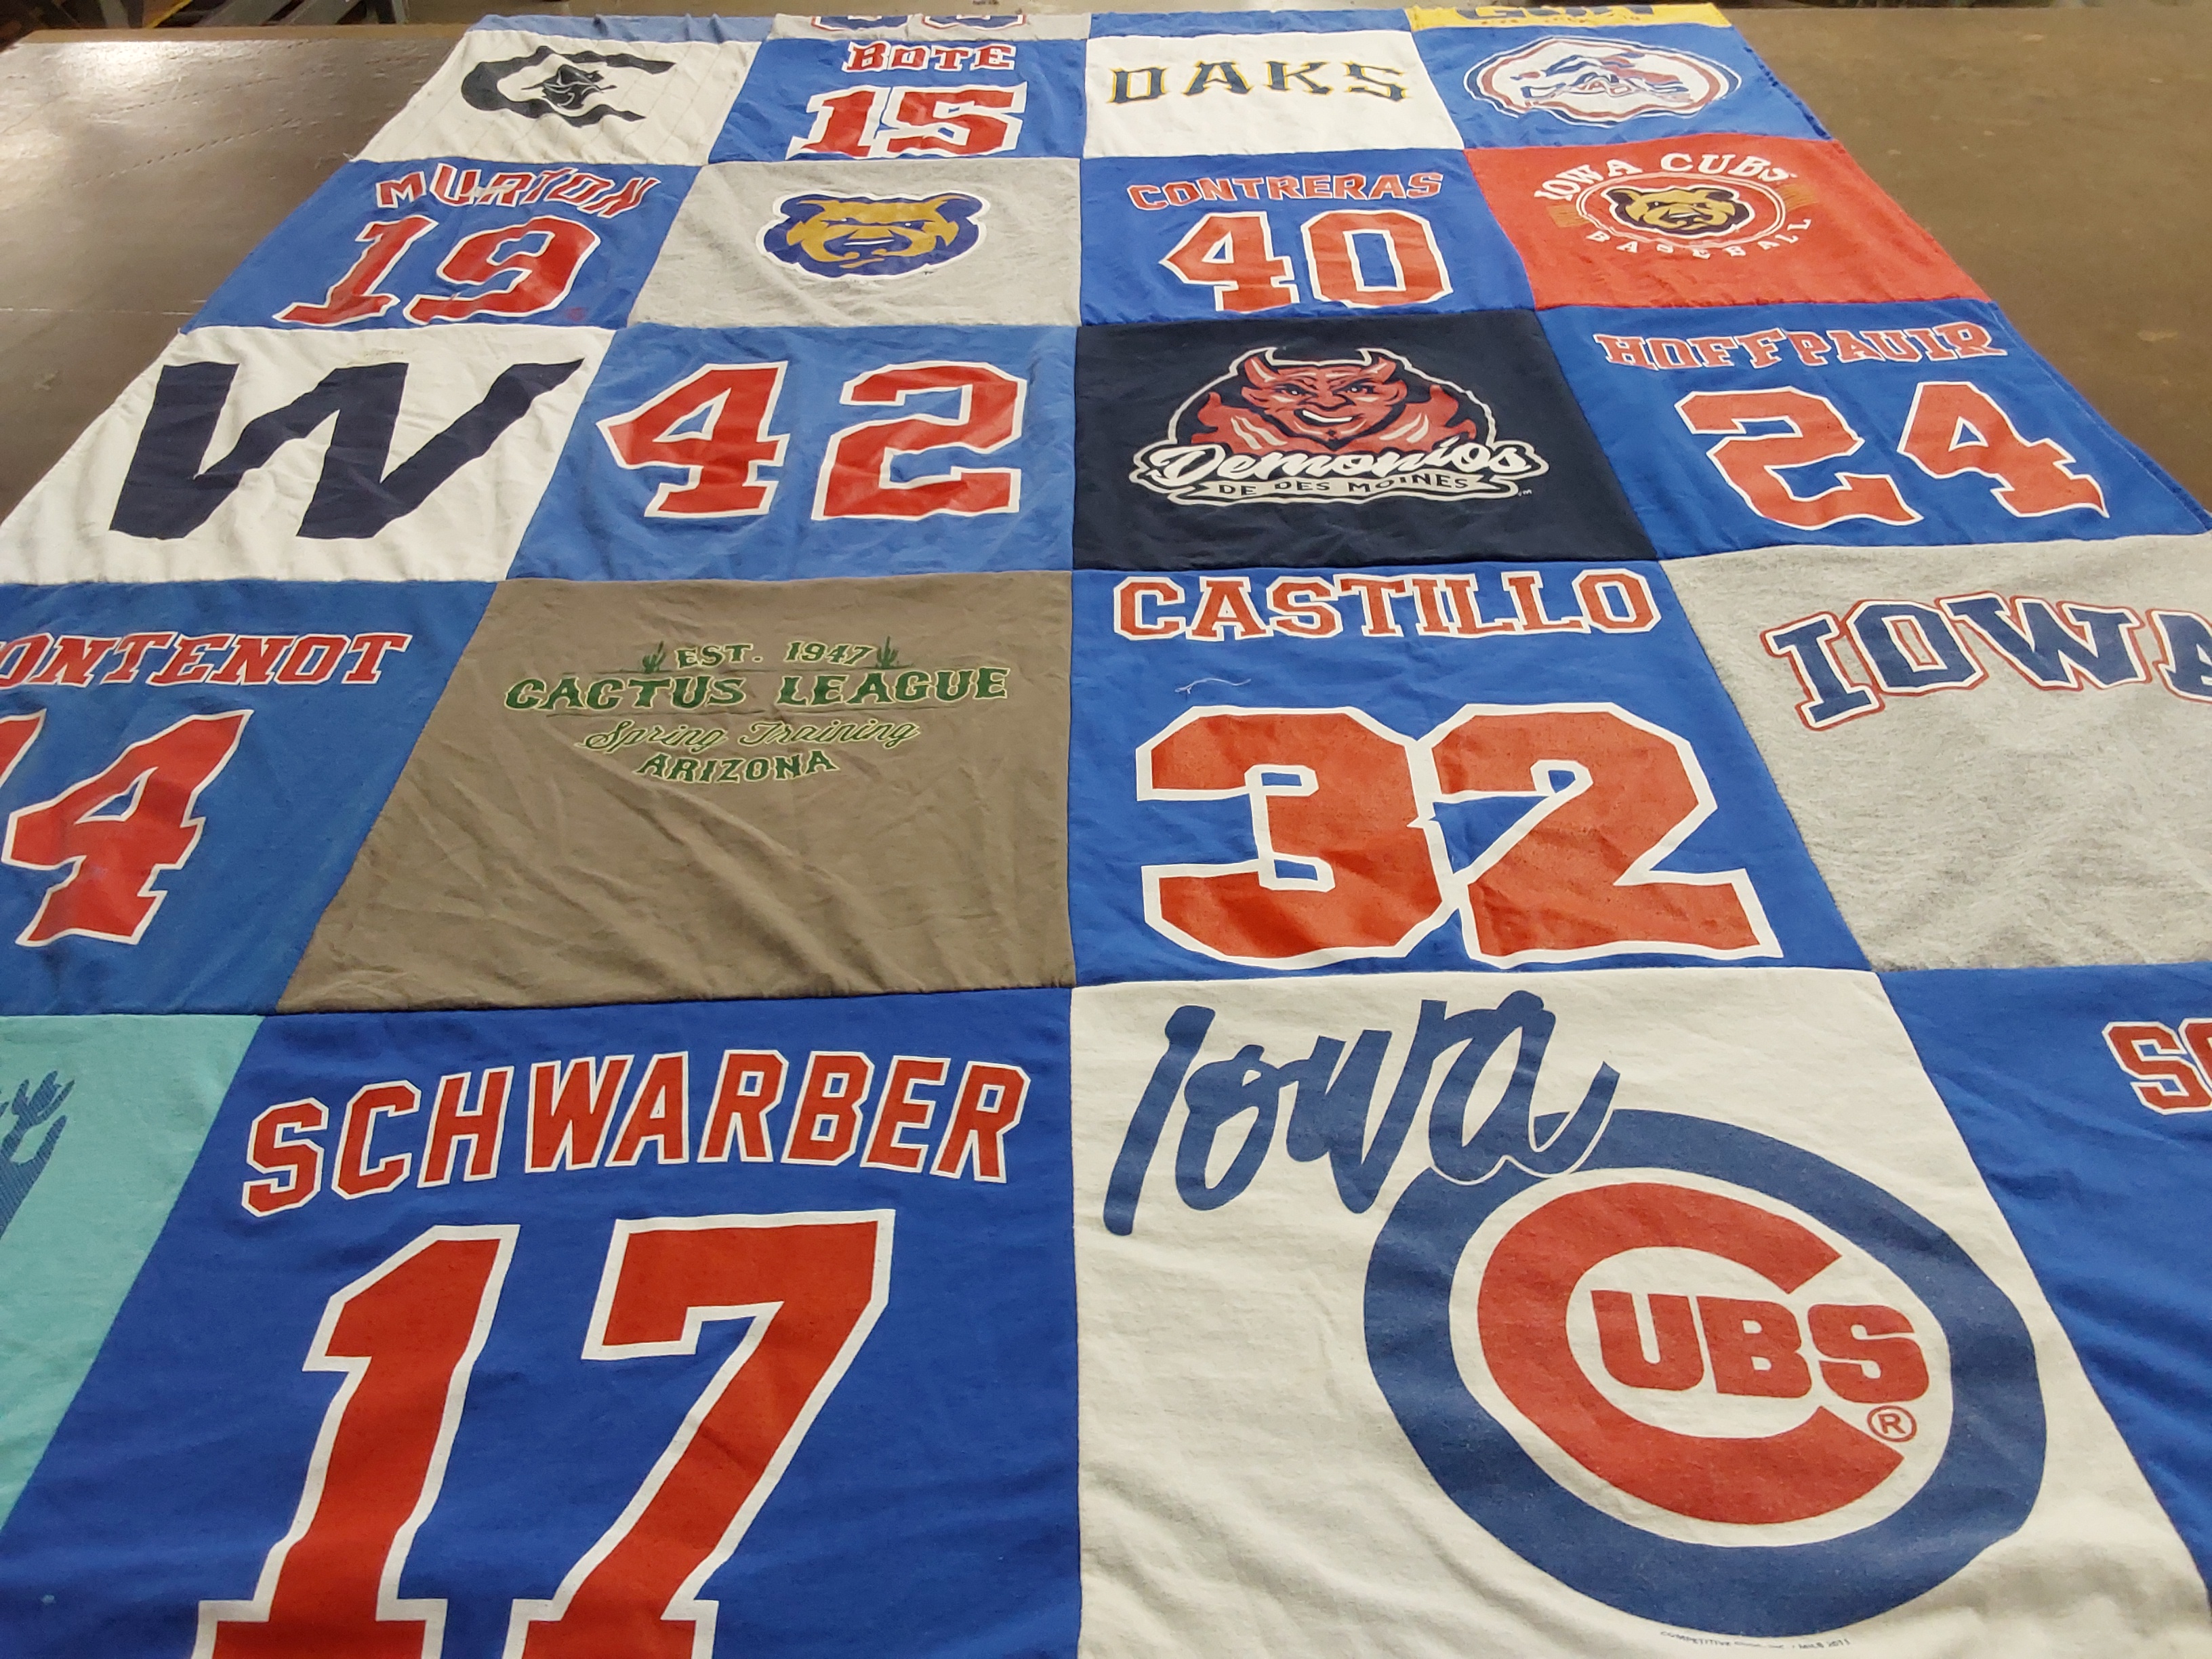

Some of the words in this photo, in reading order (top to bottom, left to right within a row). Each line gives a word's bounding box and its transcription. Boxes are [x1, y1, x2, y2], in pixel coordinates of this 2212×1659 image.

[841, 41, 1017, 73] BOTE
[1107, 60, 1411, 104] OAKS
[785, 81, 1027, 160] 15
[375, 163, 661, 218] MURTON
[1127, 173, 1443, 210] CONTRERAS
[1534, 159, 1643, 202] IOWA
[1660, 152, 1797, 182] CUBS
[1159, 209, 1453, 313] 40
[1586, 218, 1811, 260] BASEBALL
[272, 214, 600, 326] 19
[1593, 321, 2008, 371] HOFFPAUIR
[108, 358, 584, 539] W
[596, 360, 1029, 520] 42
[1149, 437, 1534, 485] Demonios
[1675, 381, 2110, 531] 24
[1218, 484, 1258, 497] DE
[1274, 479, 1331, 493] DES
[1348, 473, 1469, 493] MOINES
[1112, 569, 1661, 641] CASTILLO
[0, 632, 413, 689] ONTENOT
[674, 642, 764, 670] EST.
[784, 641, 875, 666] 1947
[504, 675, 746, 711] CACTUS
[776, 667, 1010, 706] LEAGUE
[579, 720, 730, 754] Spring
[739, 718, 922, 750] Training
[634, 750, 840, 784] ARIZONA
[1136, 703, 1784, 970] 32
[240, 1049, 1030, 1217] SCHWARBER
[1103, 990, 1620, 1237] Iowa
[191, 1210, 896, 1659] 17
